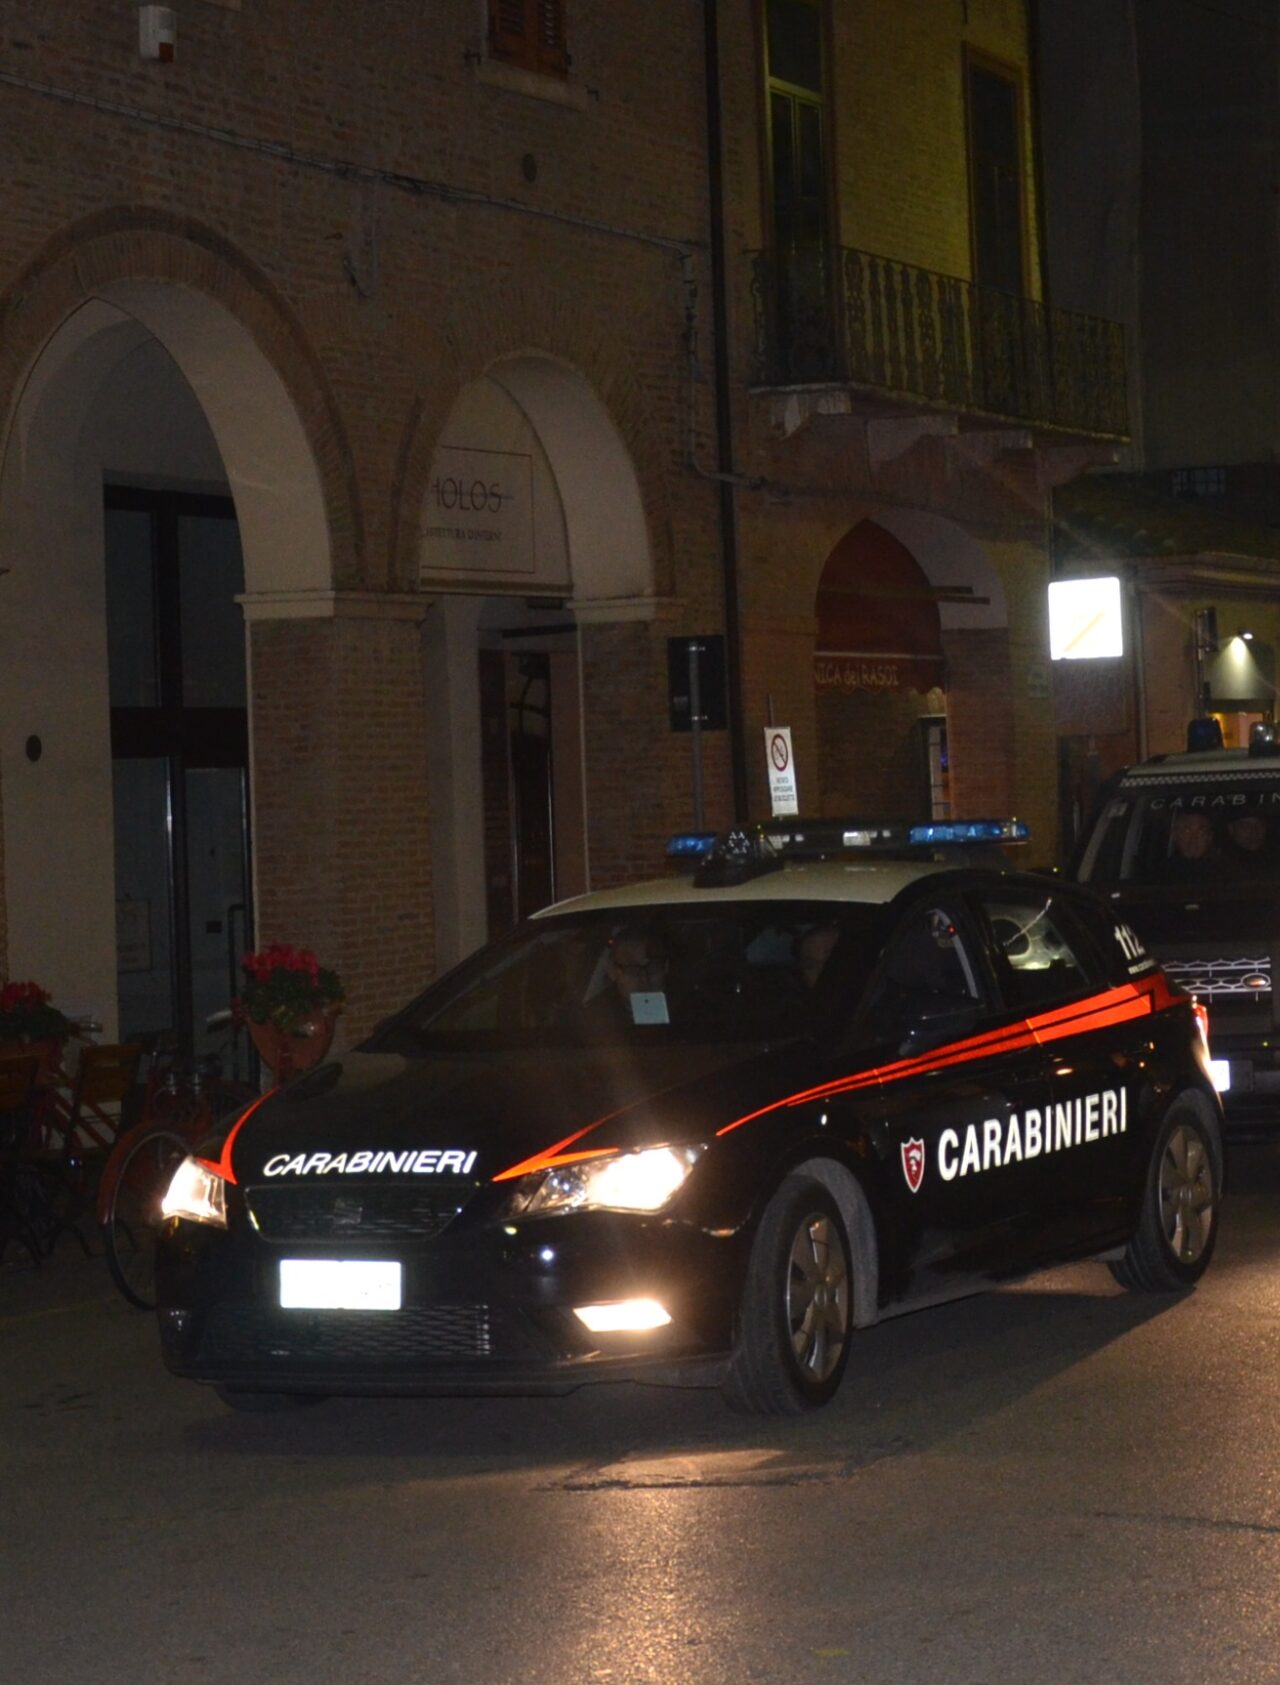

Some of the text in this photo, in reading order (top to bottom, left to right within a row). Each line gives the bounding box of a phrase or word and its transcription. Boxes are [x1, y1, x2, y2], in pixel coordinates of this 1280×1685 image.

[1114, 924, 1146, 960] 112
[937, 1086, 1127, 1182] CARABINIERI
[263, 1151, 477, 1176] CARABINIERI
